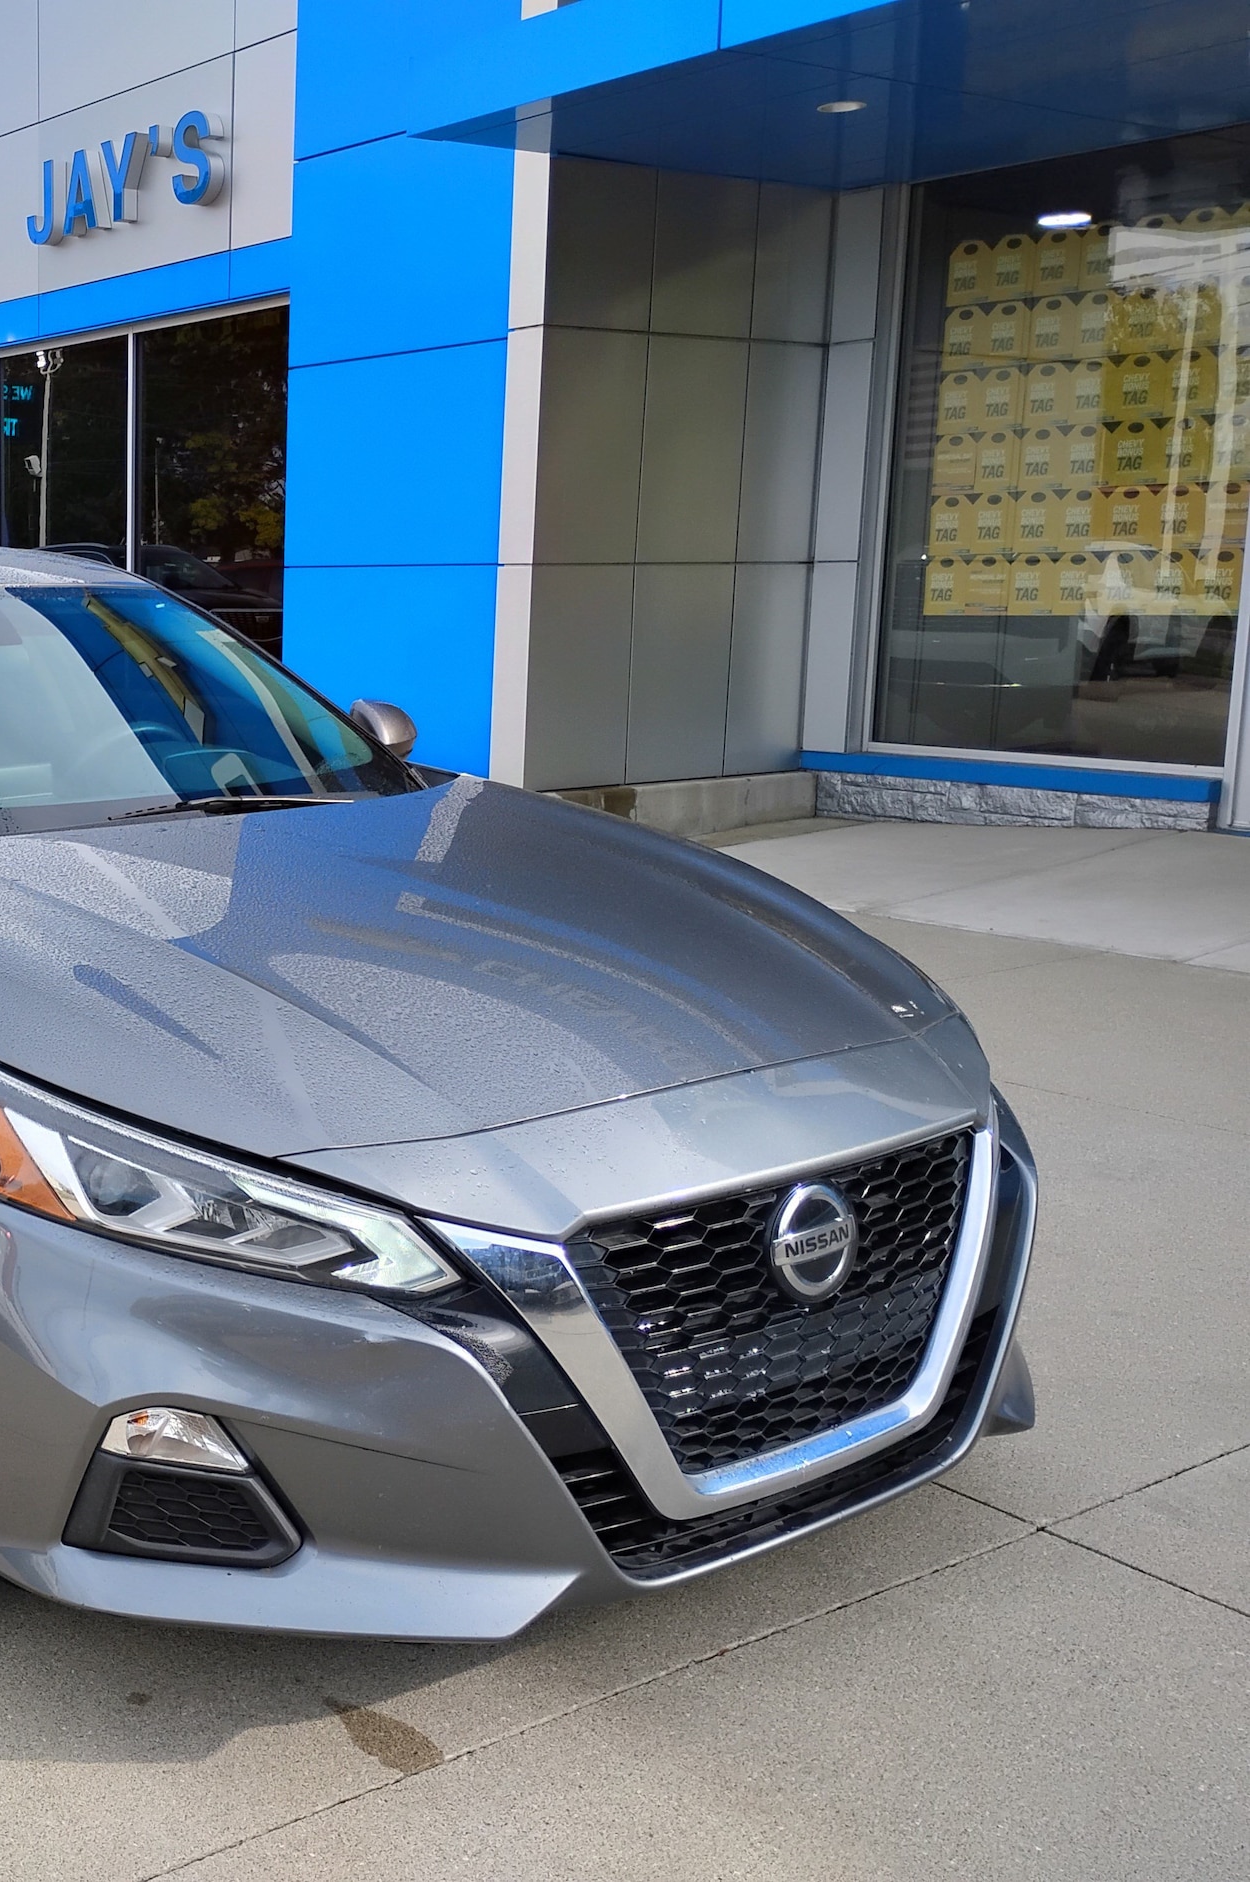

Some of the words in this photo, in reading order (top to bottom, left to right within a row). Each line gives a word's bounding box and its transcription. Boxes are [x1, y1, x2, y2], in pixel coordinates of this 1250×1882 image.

[26, 110, 225, 246] JAY'S
[996, 271, 1019, 286] TAG
[1040, 266, 1064, 281] TAG
[954, 277, 976, 292] TAG
[1036, 332, 1059, 348] TAG
[1081, 328, 1105, 343] TAG
[949, 342, 970, 356] TAG
[990, 336, 1014, 352] TAG
[1123, 372, 1150, 382] CHEVY
[1122, 390, 1148, 406] TAG
[1172, 386, 1198, 401] TG
[1030, 398, 1054, 414] TAG
[1076, 394, 1100, 409] TAG
[944, 406, 966, 420] TAG
[986, 402, 1008, 418] TAG
[1118, 438, 1144, 448] CHEVY
[1117, 448, 1144, 457] BONUS
[1025, 461, 1048, 476] TAG
[1070, 459, 1094, 474] TAG
[1116, 456, 1142, 472] TAG
[982, 465, 1004, 479] TAG
[1113, 504, 1140, 514] CHEVY
[1112, 512, 1140, 522] BONUS
[935, 528, 957, 542] TAG
[978, 526, 1000, 540] TAG
[1020, 524, 1044, 538] TAG
[1066, 522, 1090, 538] TAG
[1112, 521, 1138, 536] TAG
[1016, 572, 1040, 580] CHEVY
[1060, 571, 1086, 579] CHEVY
[1204, 577, 1233, 586] BONUS
[930, 588, 952, 602] TAG
[1015, 587, 1038, 601] TAG
[1060, 586, 1084, 601] TAG
[1204, 585, 1232, 600] TAG
[784, 1223, 850, 1258] NISSAN
